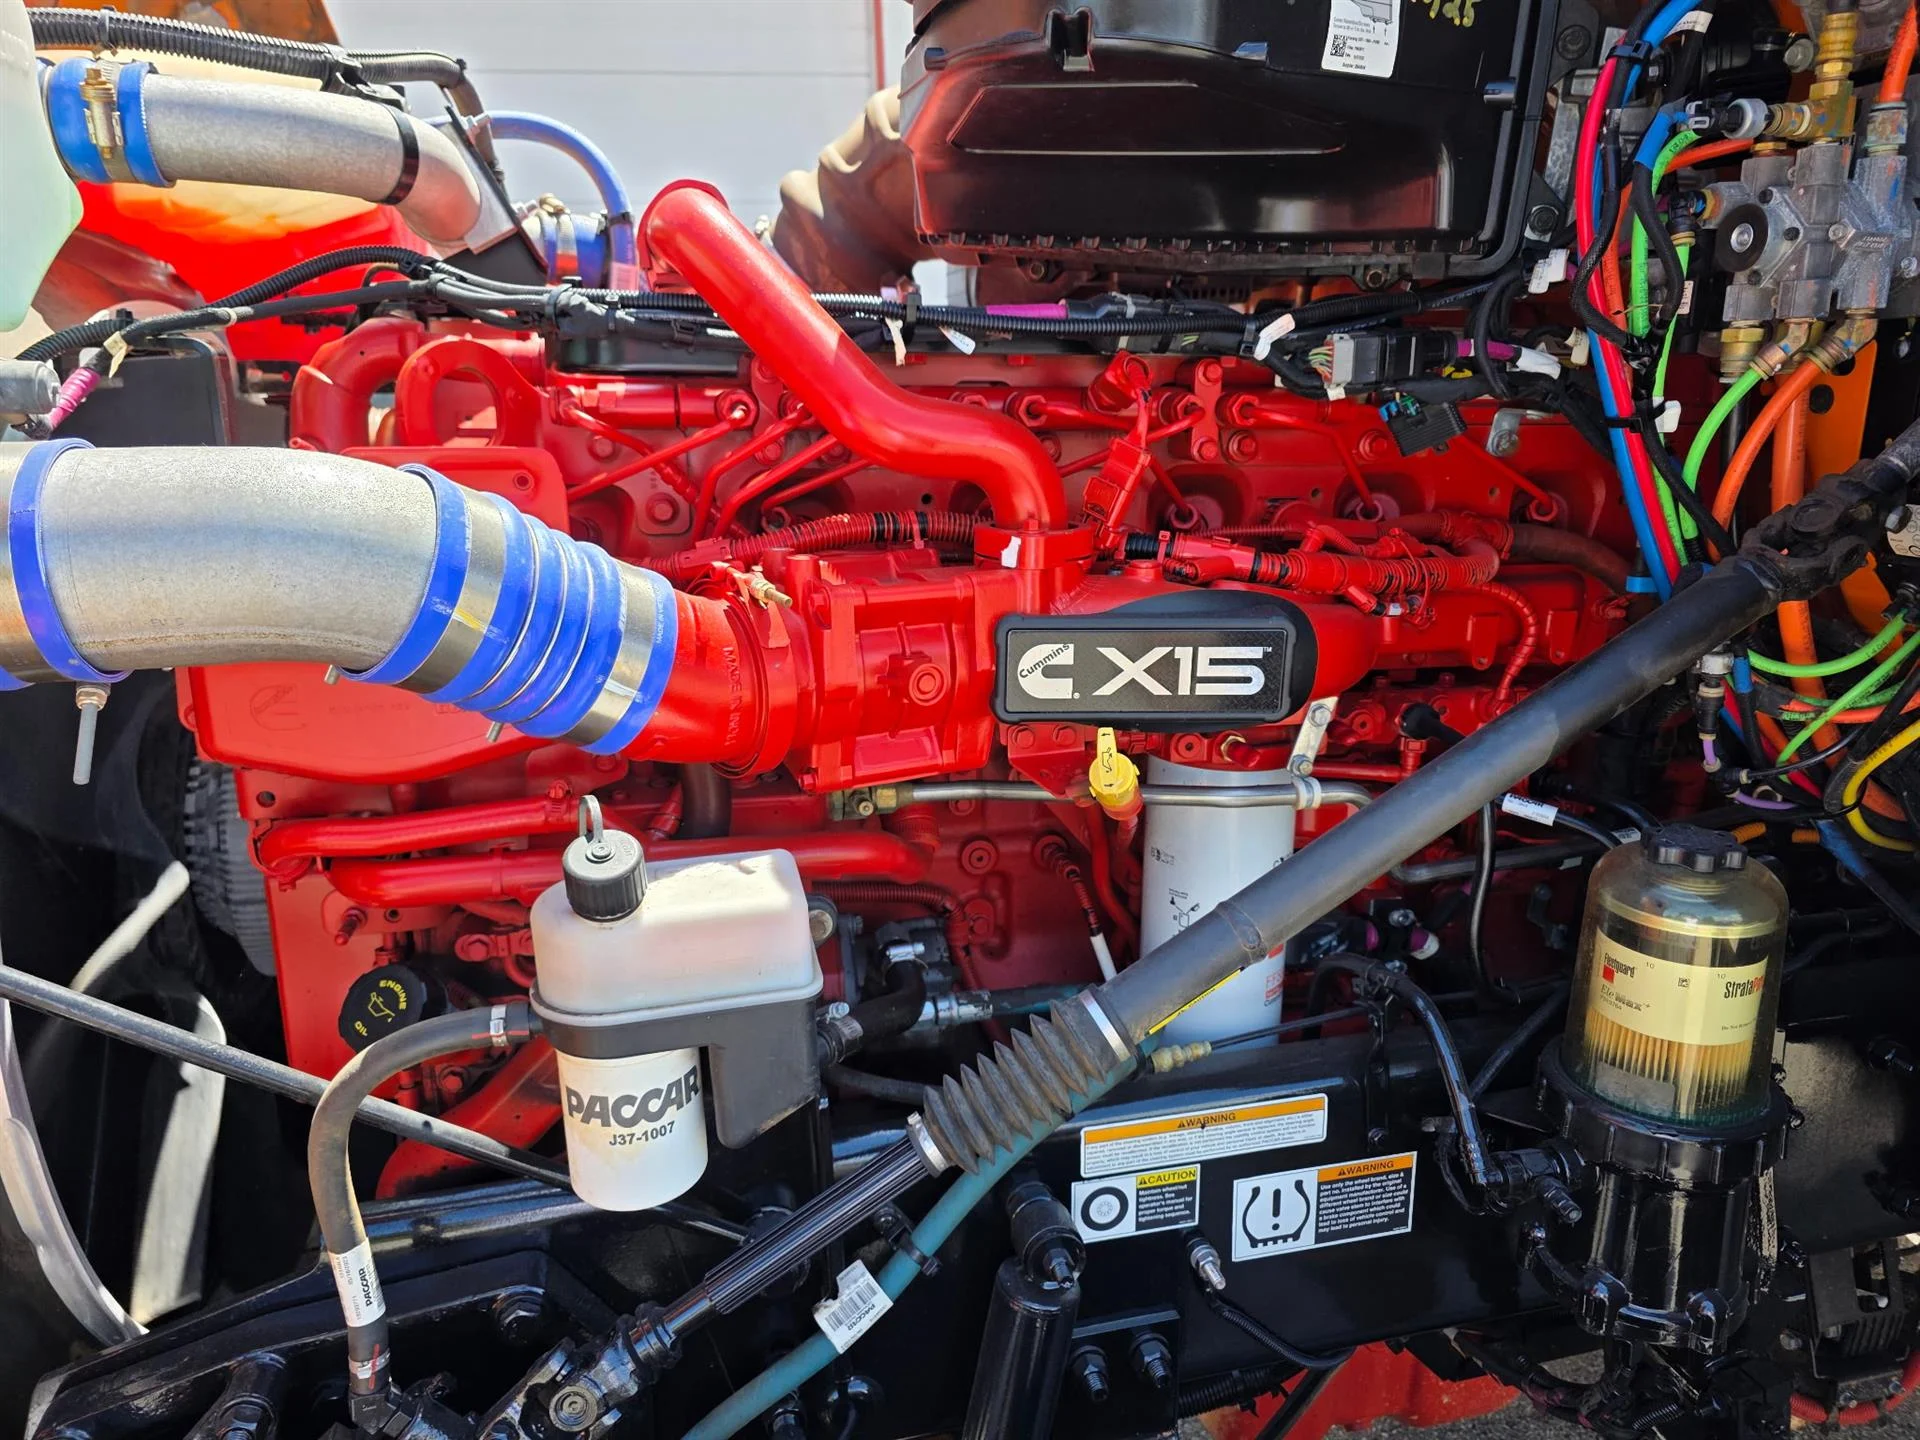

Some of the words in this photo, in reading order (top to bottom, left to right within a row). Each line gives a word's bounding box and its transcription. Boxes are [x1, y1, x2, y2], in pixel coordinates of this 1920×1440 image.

[1019, 643, 1070, 679] Cummins
[1092, 646, 1265, 695] X15
[1604, 953, 1635, 978] Fleetguard
[379, 980, 407, 1010] ENGINE
[355, 1021, 368, 1036] OIL
[566, 1065, 700, 1128] PACCAR
[1186, 1112, 1236, 1127] WARNING
[608, 1121, 675, 1146] J37-1007
[1347, 1161, 1394, 1175] WARNING
[1148, 1169, 1196, 1184] CAUTION
[1341, 1185, 1364, 1193] installed
[1319, 1193, 1348, 1202] equipment
[1319, 1200, 1341, 1208] different
[1138, 1207, 1155, 1215] proper
[1339, 1208, 1368, 1217] component
[1349, 1220, 1372, 1228] personal
[359, 1267, 372, 1307] PACCAR
[848, 1303, 876, 1330] PACCAR
